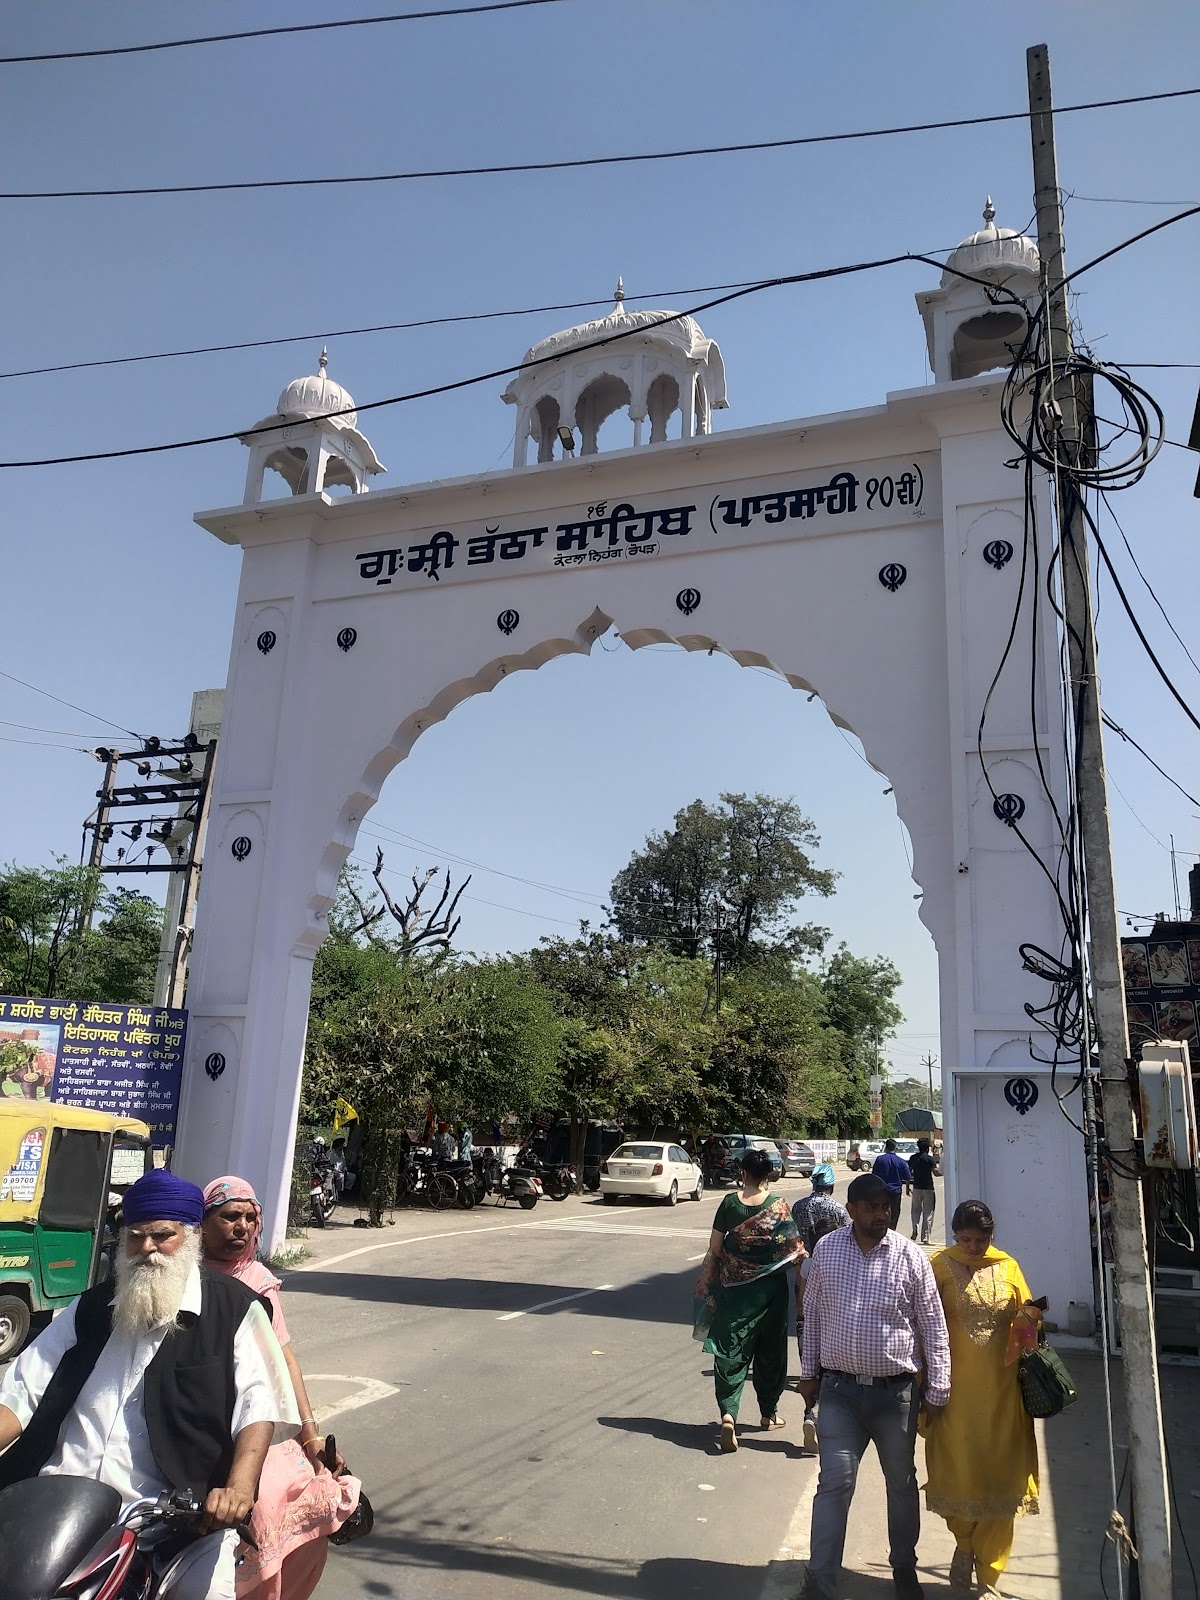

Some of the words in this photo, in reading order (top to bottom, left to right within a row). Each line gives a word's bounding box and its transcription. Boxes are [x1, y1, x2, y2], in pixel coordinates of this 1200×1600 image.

[466, 525, 549, 566] ਭੱਠਾ
[556, 503, 697, 551] ਸਾਹਿਬ
[709, 472, 860, 534] (ਪਾਤਸ਼ਾਹੀ
[10, 1000, 46, 1018] ਸ਼ਹੀਦ
[49, 1003, 78, 1021] ਭਾਈ
[127, 1008, 151, 1027] ਸਿੰਘ
[155, 1011, 169, 1028] ਜੀ
[168, 1018, 185, 1030] ਅਤੇ
[63, 1023, 120, 1042] ਇਤਿਹਾਸਕ
[124, 1028, 161, 1045] ਪਵਿੱਤਰ
[165, 1034, 181, 1052] ਖੂਹ
[98, 1046, 127, 1057] ਨਿਹੰਗ
[60, 1067, 72, 1075] ਅਤੇ
[152, 1081, 160, 1089] ਜੀ
[163, 1091, 171, 1099] ਜੀ
